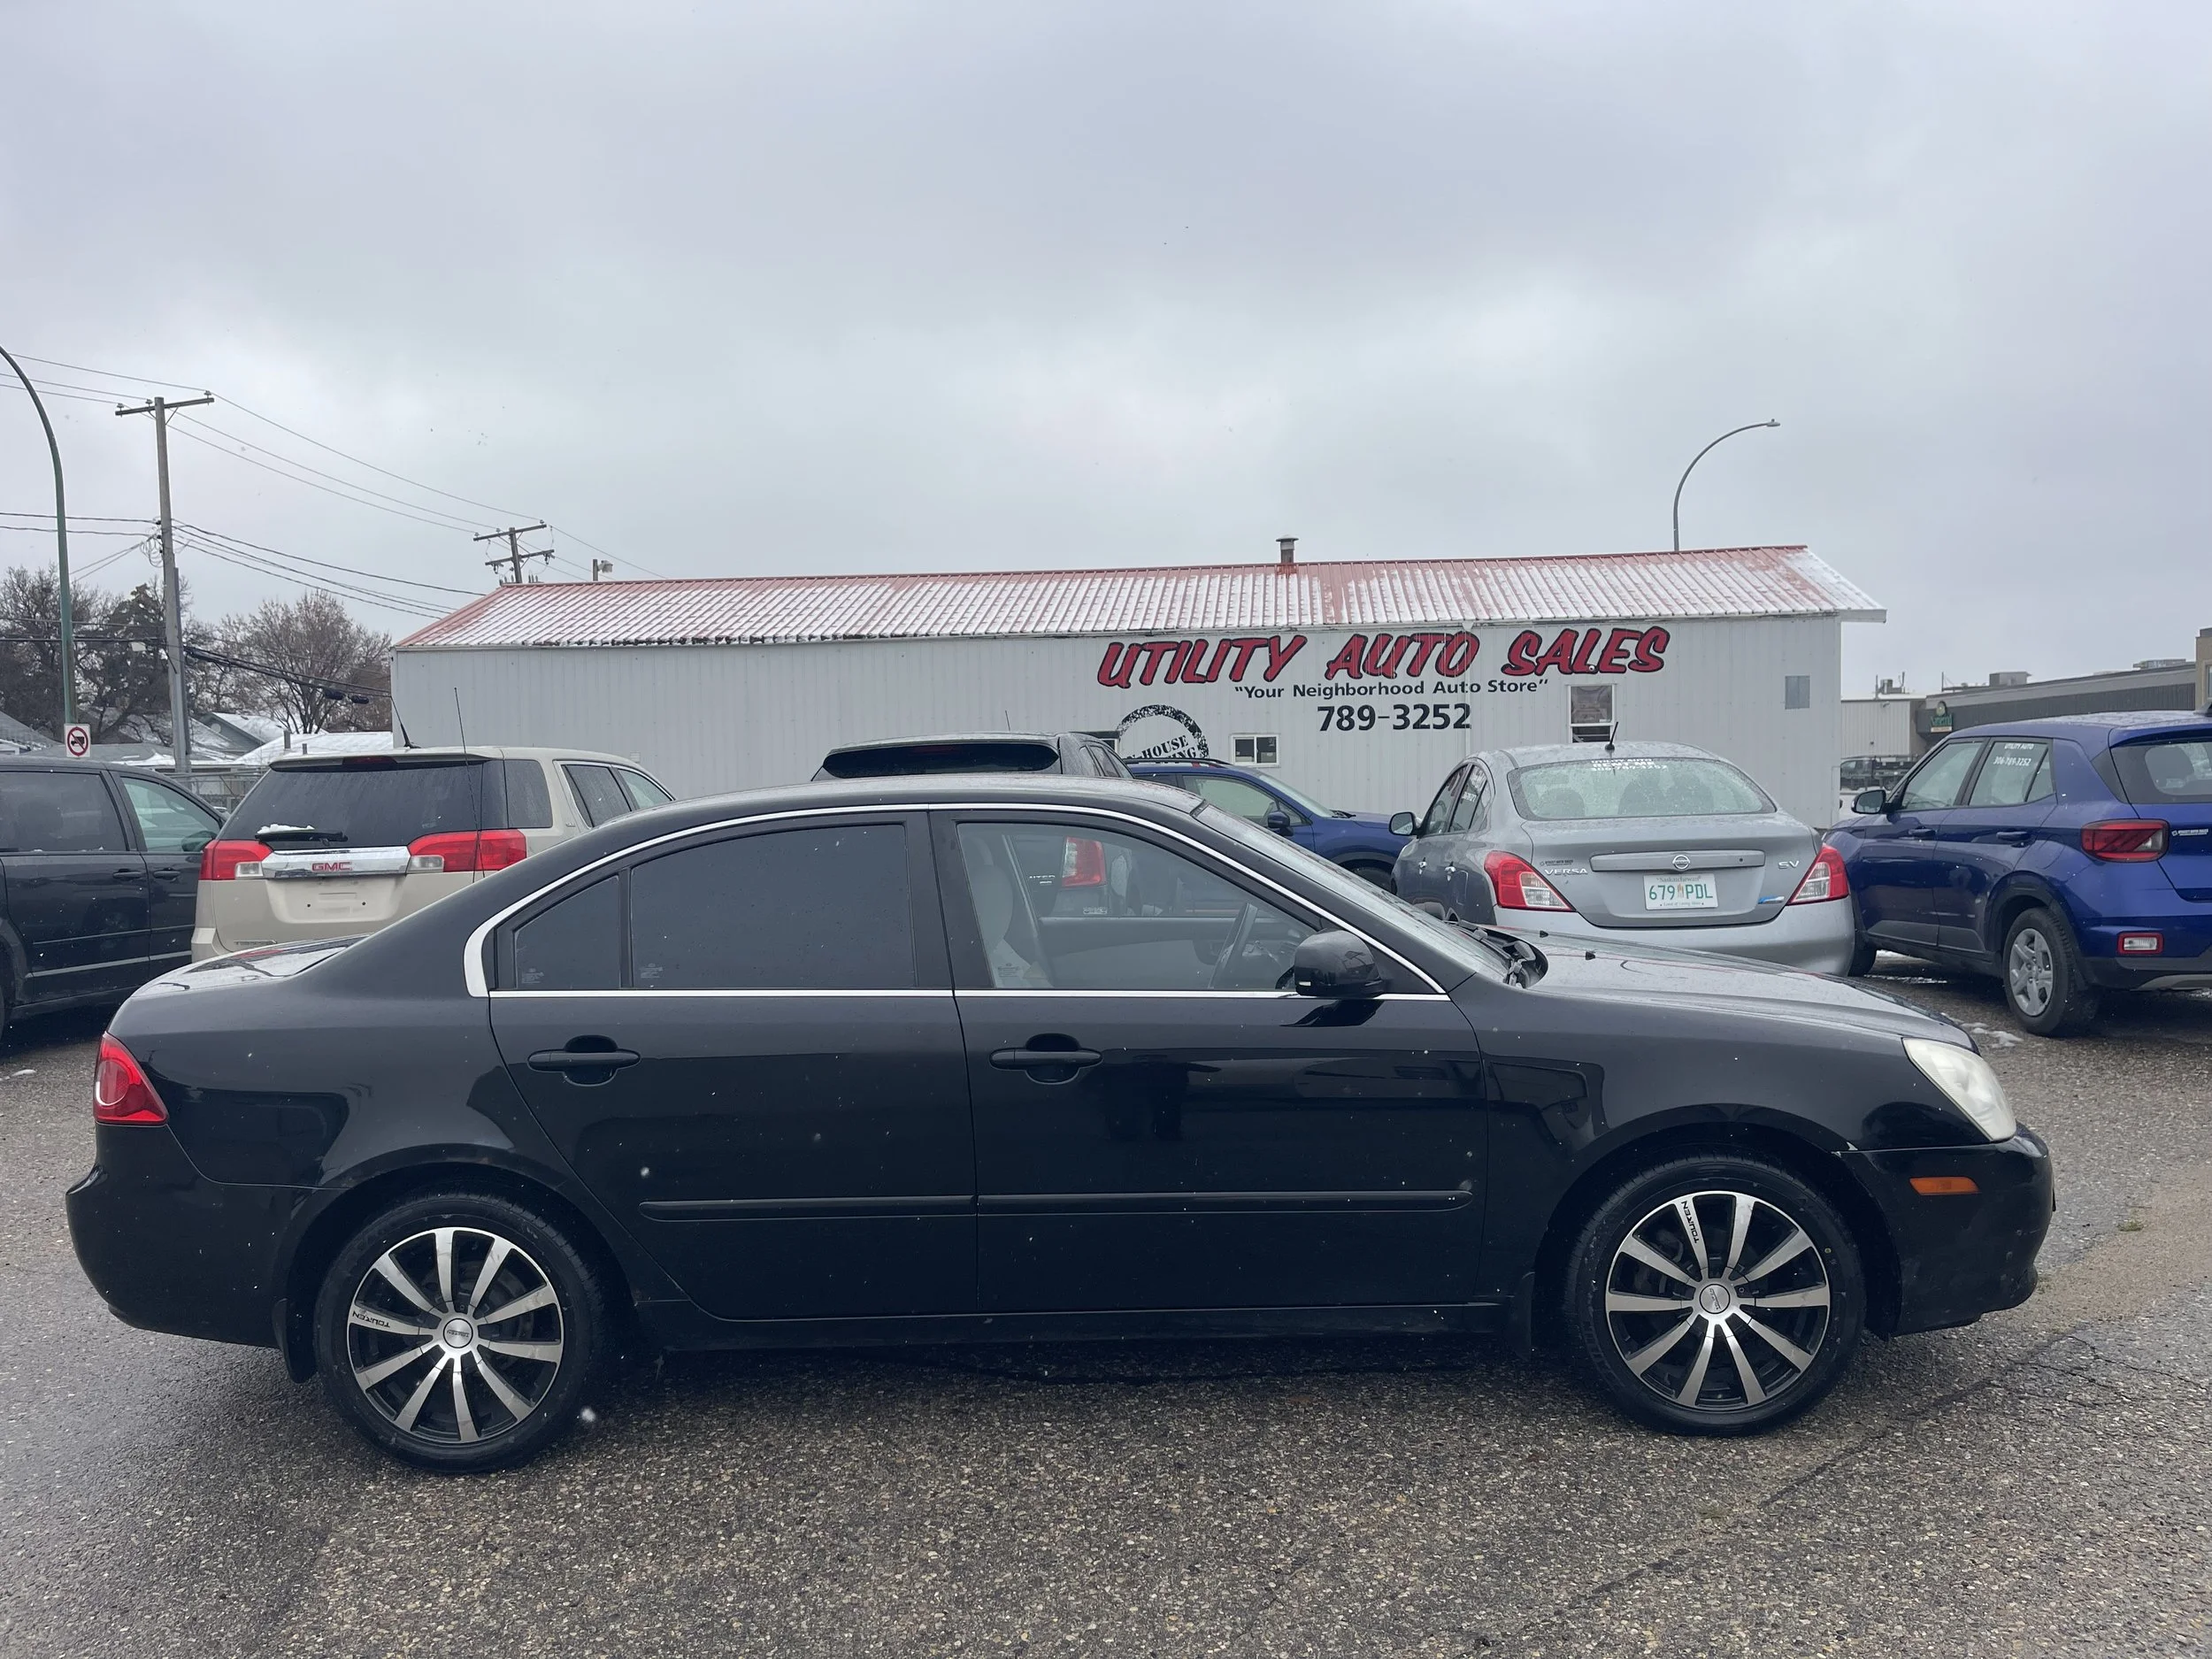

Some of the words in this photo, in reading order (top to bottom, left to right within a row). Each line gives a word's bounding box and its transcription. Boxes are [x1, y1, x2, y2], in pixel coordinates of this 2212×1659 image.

[1097, 635, 1308, 689] UTILITY
[1325, 630, 1480, 680] AUTO
[1501, 626, 1671, 677] SALES
[1293, 680, 1425, 700] Neighborhood
[1432, 680, 1481, 694] Auto
[1317, 703, 1471, 731] 789-3252
[311, 861, 353, 872] GMC
[1778, 860, 1800, 869] SV
[1649, 885, 1676, 900] 679
[1685, 884, 1714, 900] PDL
[1681, 1200, 1700, 1243] TOUREN
[352, 1311, 390, 1328] TOUREN
